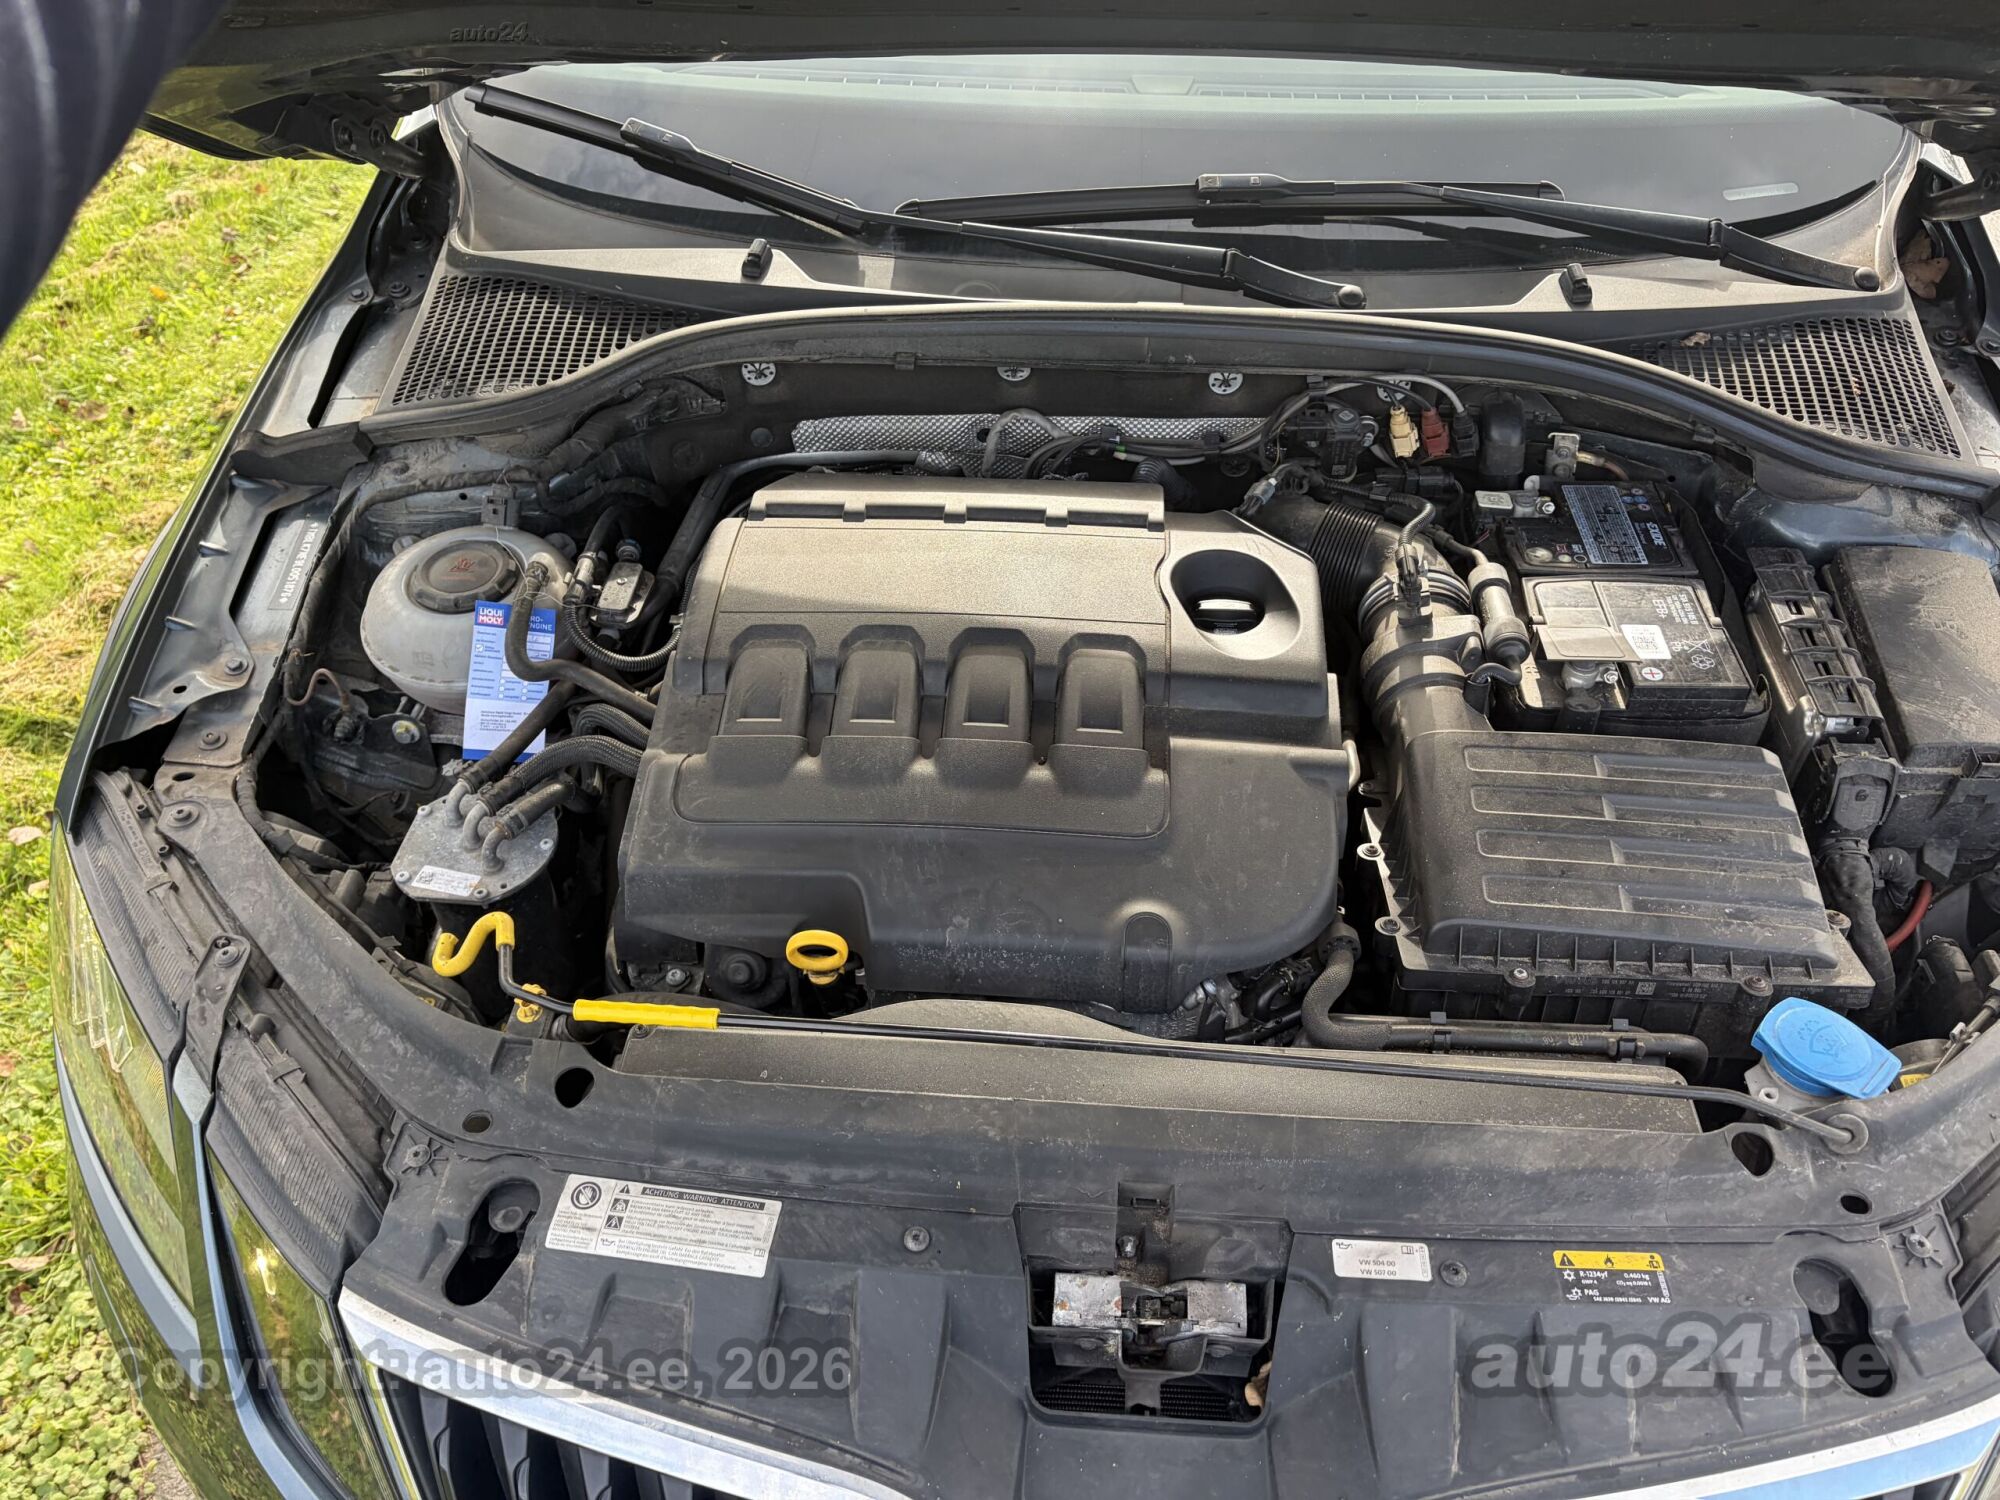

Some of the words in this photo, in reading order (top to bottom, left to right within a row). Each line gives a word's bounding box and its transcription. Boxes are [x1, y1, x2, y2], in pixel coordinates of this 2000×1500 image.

[479, 607, 503, 616] LIQUI
[1652, 599, 1669, 619] EFB+
[478, 615, 504, 626] MOLY
[644, 1187, 680, 1199] ACHTUNG
[683, 1192, 718, 1204] WARNING
[721, 1197, 761, 1210] ATTENTION
[1372, 1259, 1385, 1267] 504
[1579, 1270, 1608, 1280] R-1234yf
[1583, 1288, 1600, 1296] PAG
[1646, 1296, 1660, 1304] VW
[1660, 1296, 1672, 1304] AG
